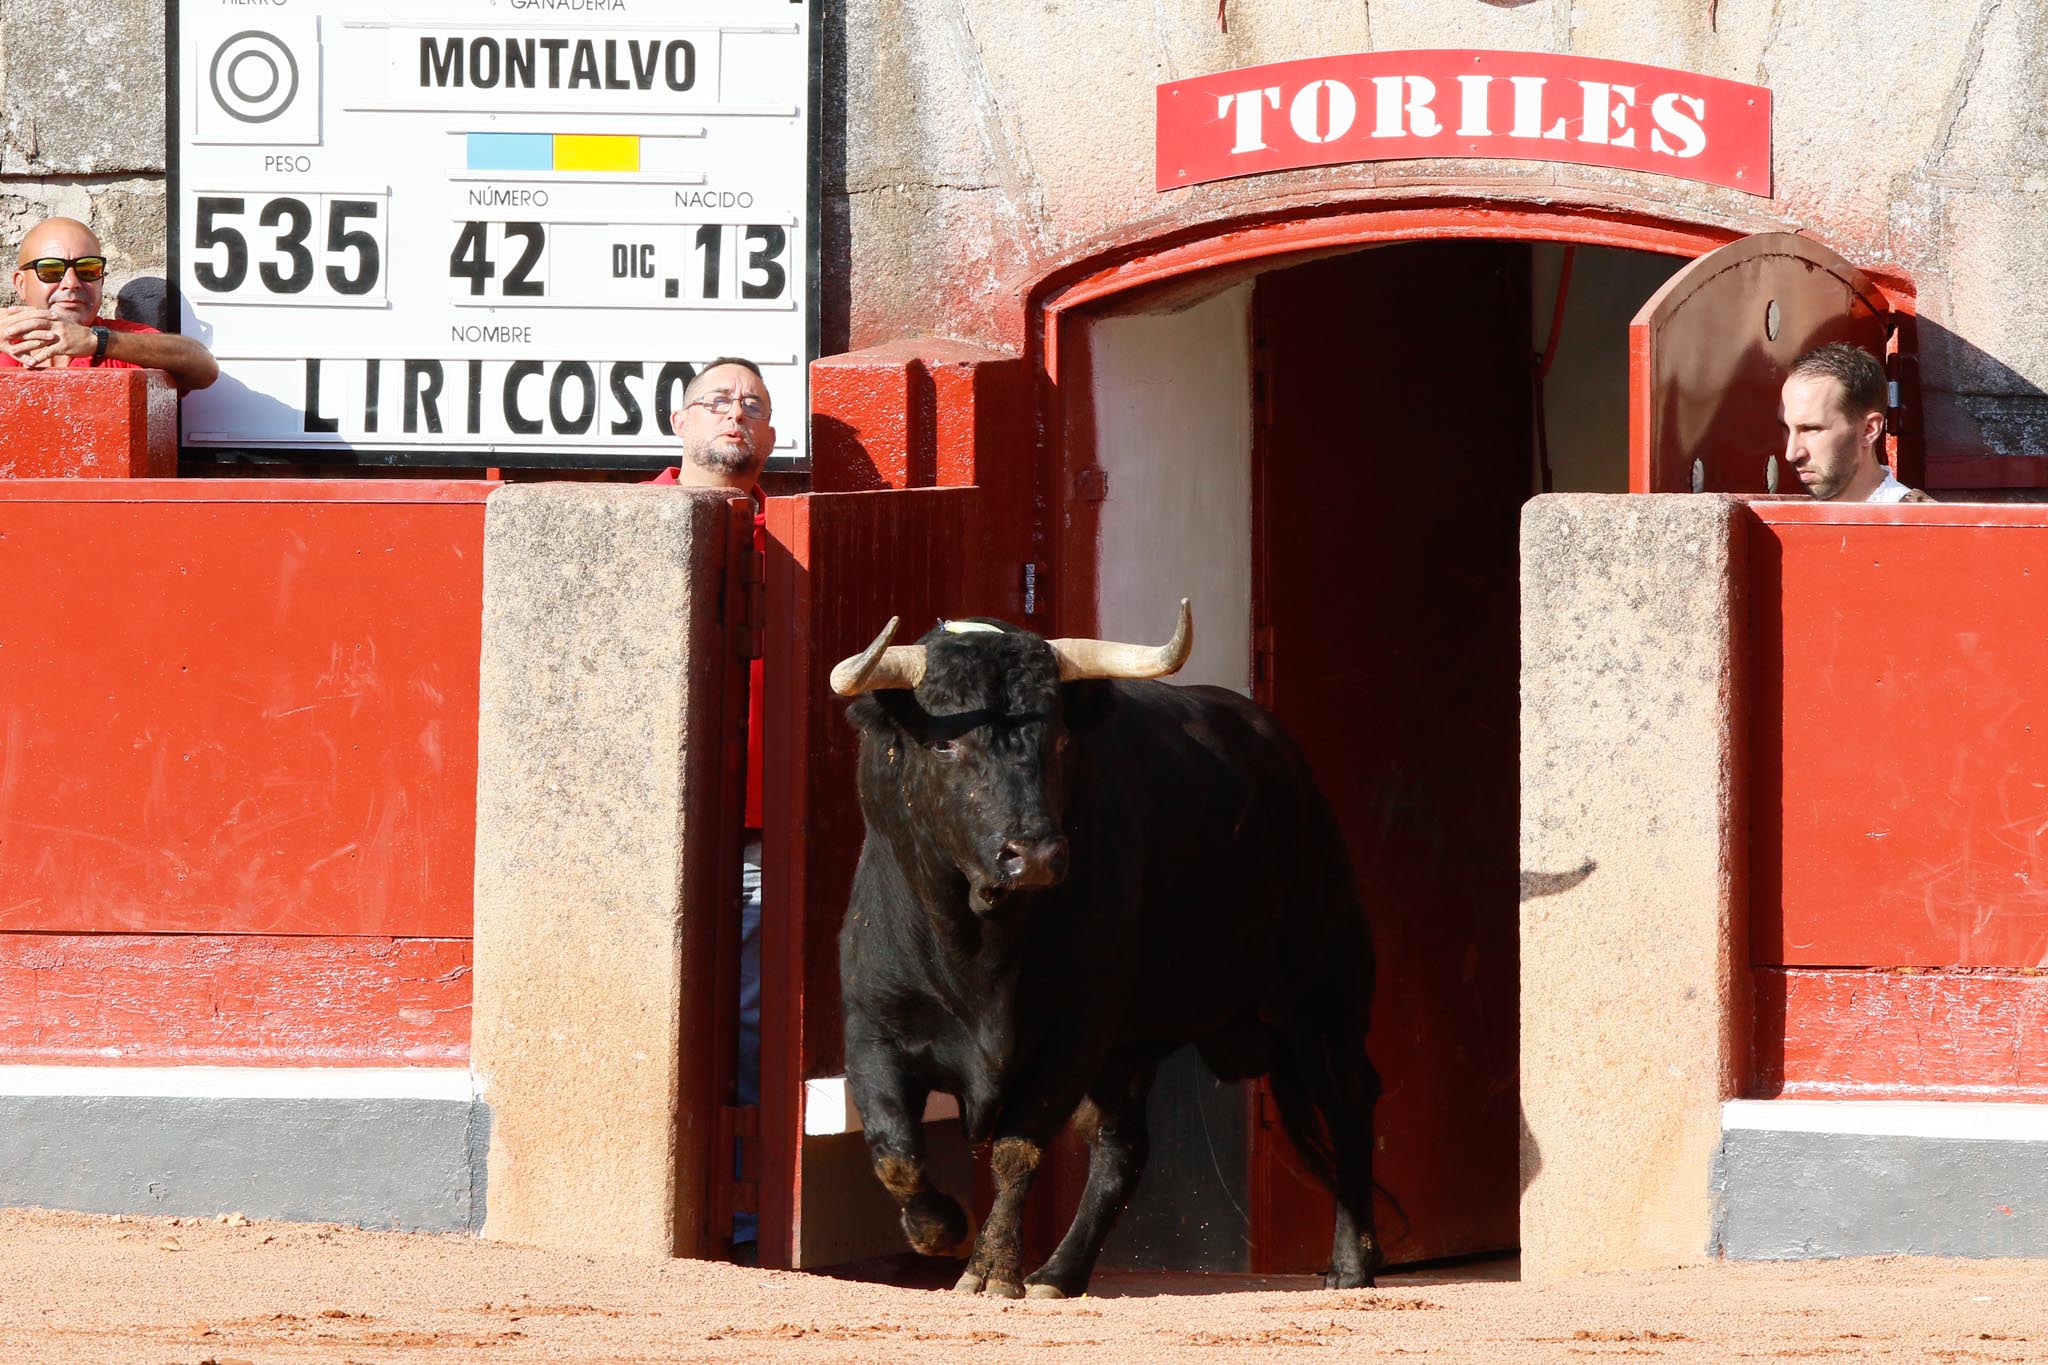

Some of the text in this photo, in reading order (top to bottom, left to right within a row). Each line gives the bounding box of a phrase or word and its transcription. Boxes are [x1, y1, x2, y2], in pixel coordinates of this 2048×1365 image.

[419, 36, 696, 92] MONTALVO
[1218, 74, 1708, 158] TORILES
[265, 155, 311, 173] PESO
[469, 186, 549, 207] NÚMERO
[675, 191, 753, 208] NACIDO
[194, 196, 380, 295] 535
[450, 222, 546, 296] 42
[452, 325, 532, 343] NOMBRE
[304, 358, 697, 436] LIRICOSO
